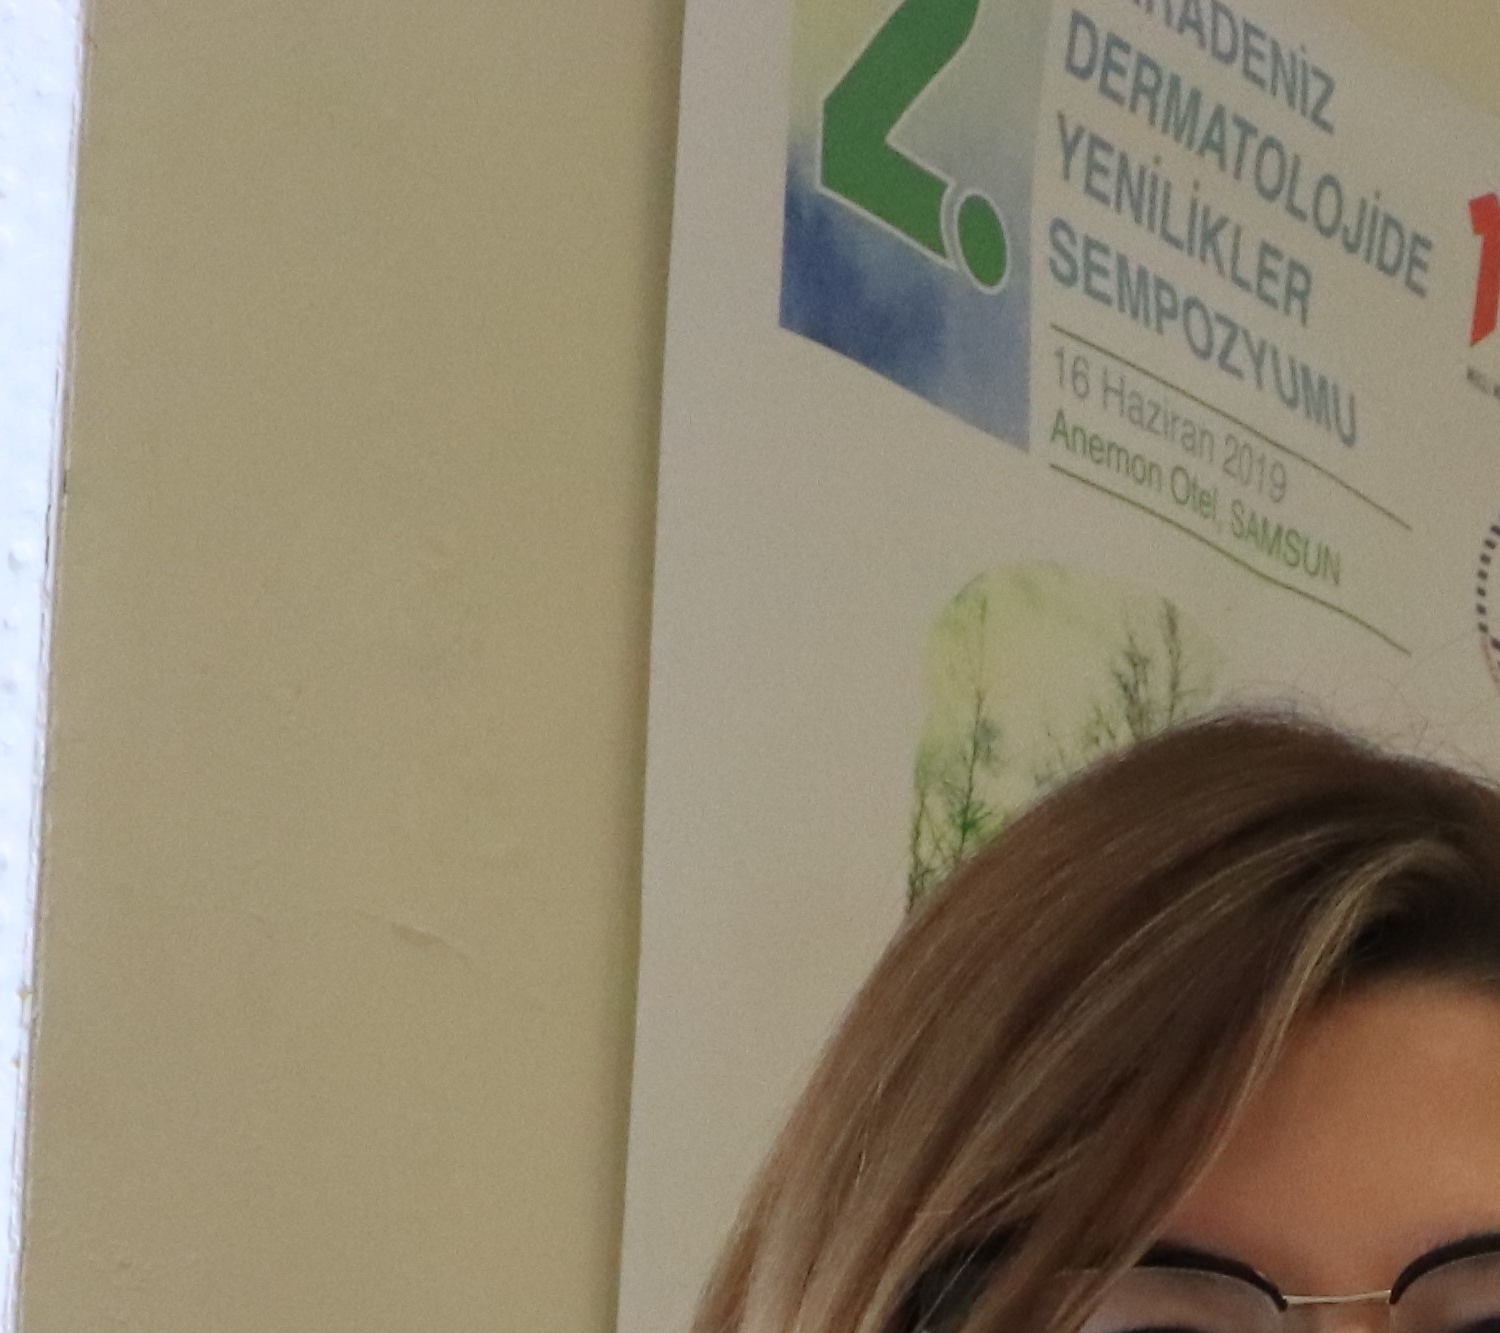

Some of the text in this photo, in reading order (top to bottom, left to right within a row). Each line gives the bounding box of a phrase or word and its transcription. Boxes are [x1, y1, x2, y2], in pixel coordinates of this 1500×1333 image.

[1056, 110, 1312, 328] YENİLİKLER
[1064, 9, 1433, 297] DERMATOLOJİDE
[1048, 217, 1357, 448] SEMPOZYUMU
[1053, 345, 1288, 503] 16 Haziran 2019
[1049, 408, 1162, 492] Anemon
[1230, 500, 1341, 587] SAMSUN
